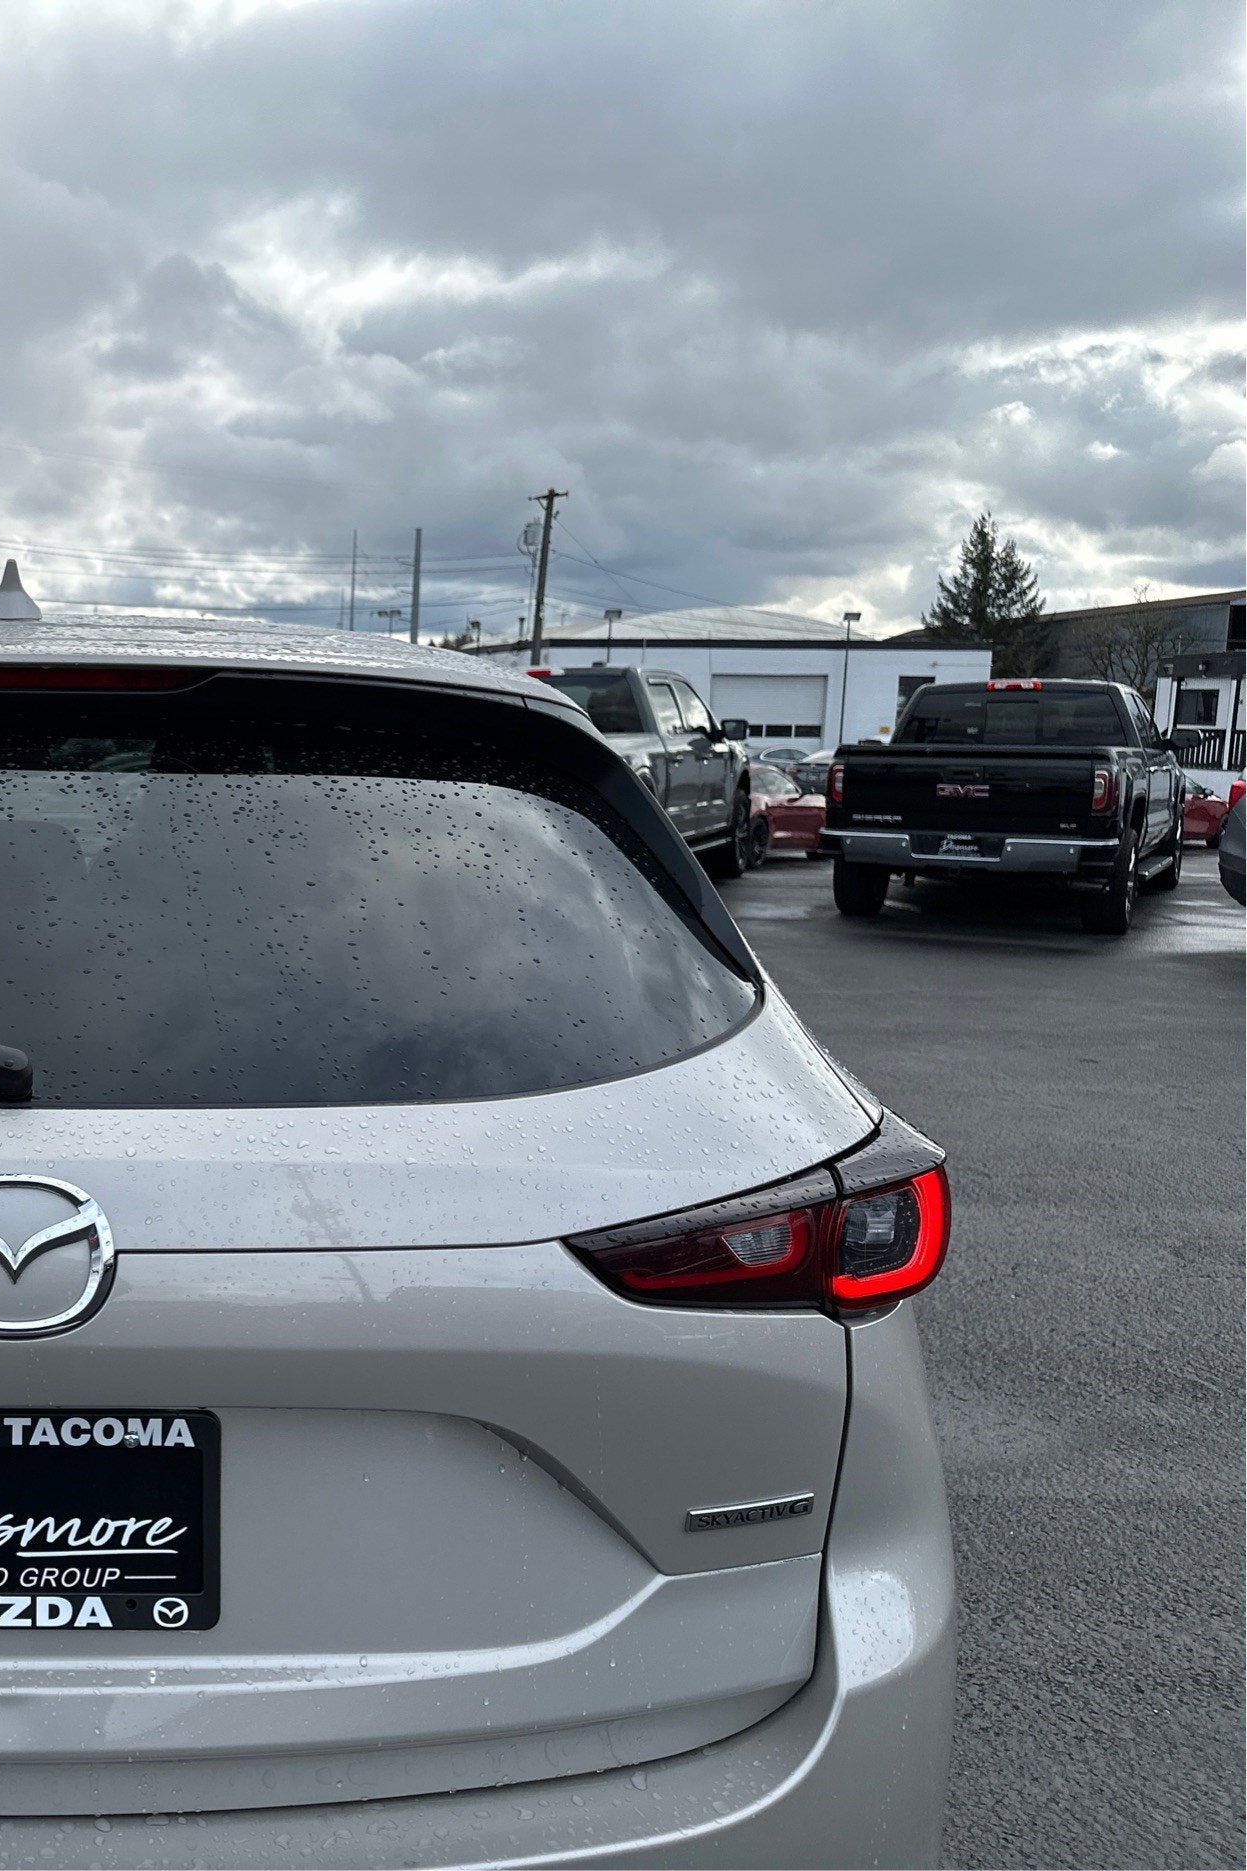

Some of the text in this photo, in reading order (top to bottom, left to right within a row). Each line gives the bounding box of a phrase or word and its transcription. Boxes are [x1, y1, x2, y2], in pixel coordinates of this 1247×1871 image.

[936, 783, 990, 797] GMC
[4, 1417, 195, 1448] TACOMA
[19, 1567, 121, 1588] GROUP
